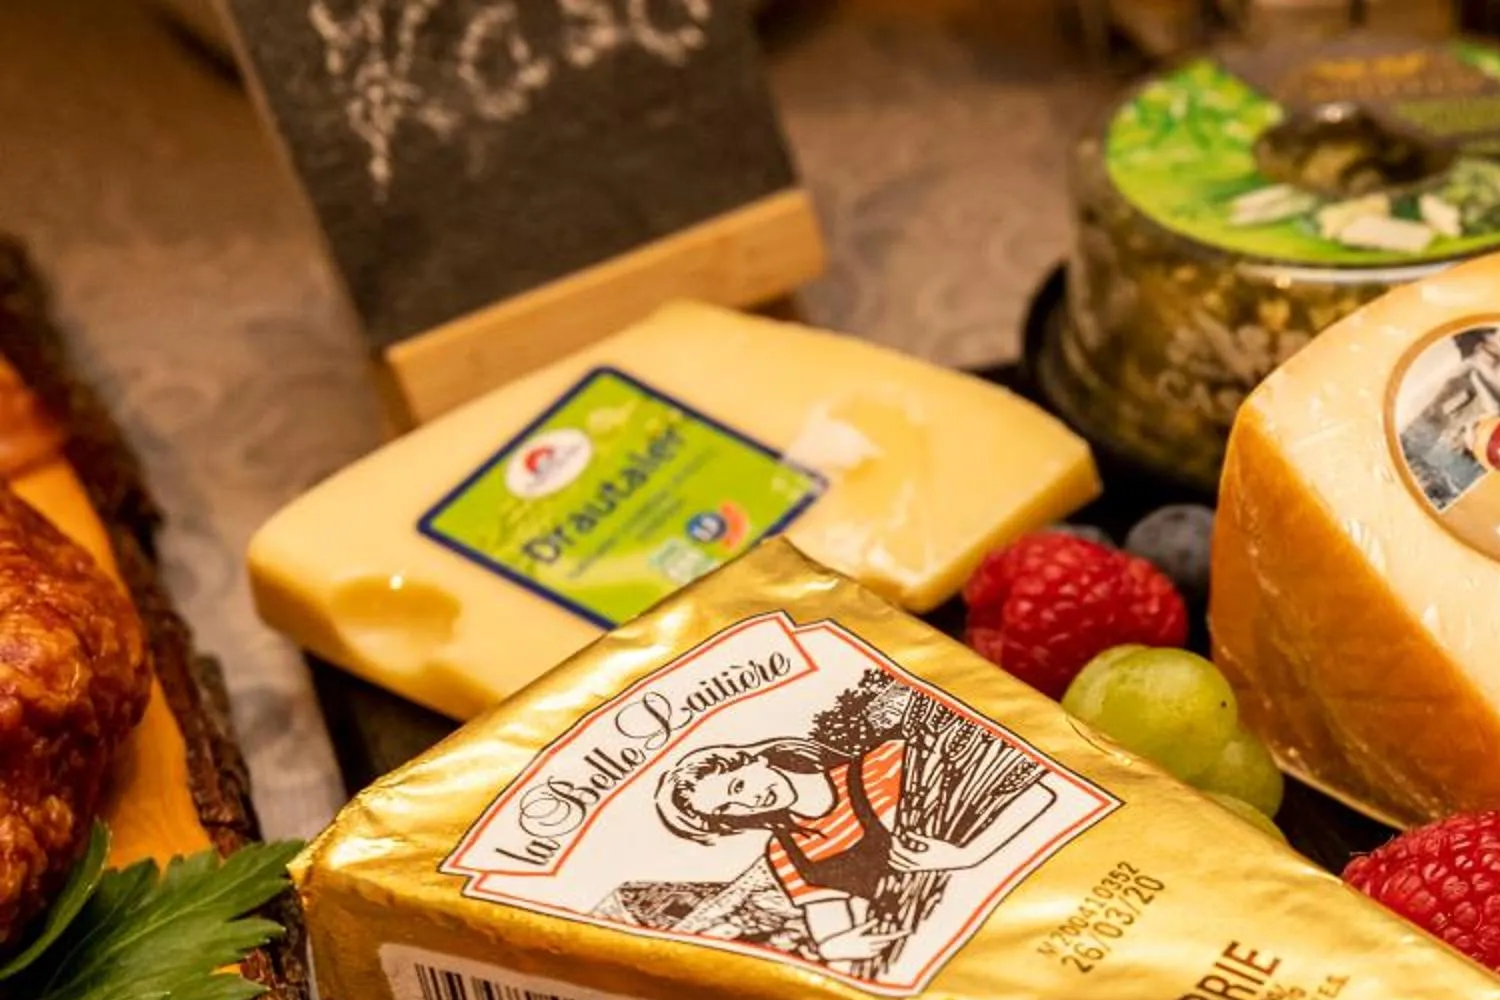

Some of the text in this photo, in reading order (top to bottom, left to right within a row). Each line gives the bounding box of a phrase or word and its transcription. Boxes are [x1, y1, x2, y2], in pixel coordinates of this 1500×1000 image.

[522, 423, 684, 563] Drautaler
[519, 747, 646, 838] Belle
[615, 651, 791, 751] Laitière
[1061, 874, 1166, 975] 26/03/20
